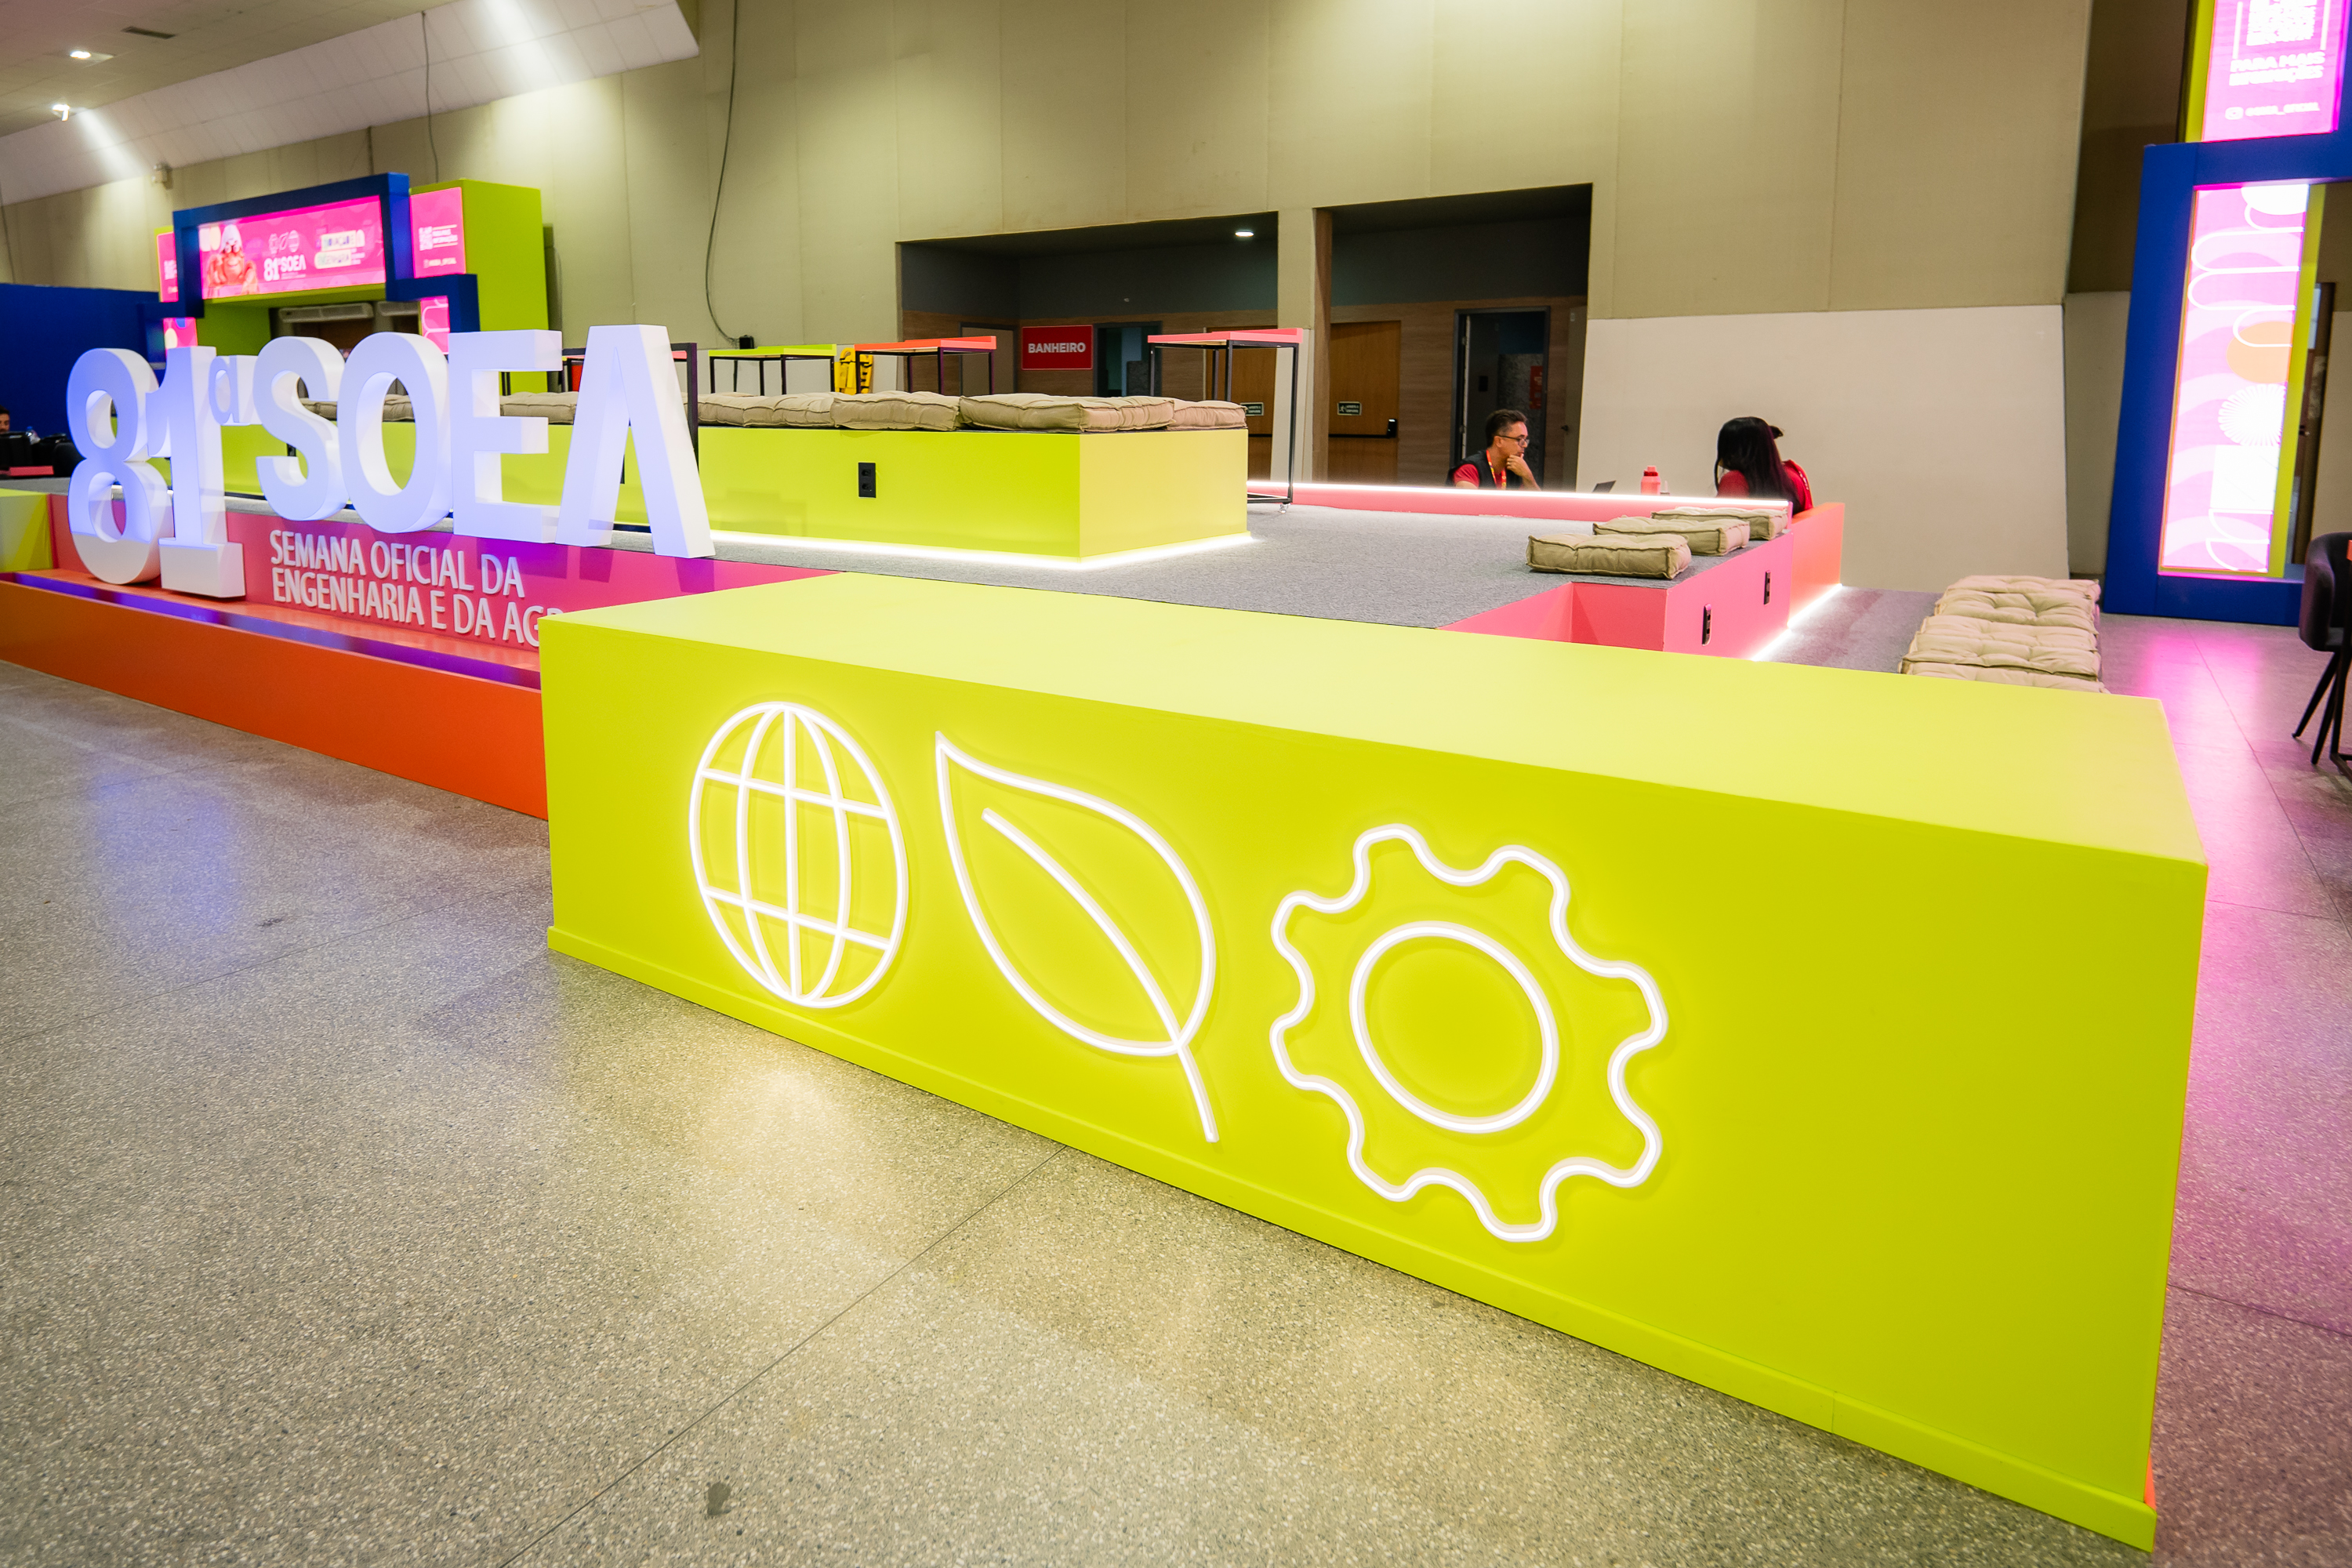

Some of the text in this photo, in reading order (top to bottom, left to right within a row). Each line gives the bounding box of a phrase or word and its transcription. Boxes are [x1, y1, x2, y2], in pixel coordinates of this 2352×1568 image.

[1028, 342, 1087, 354] BANHEIRO
[270, 529, 525, 598] SEMANA OFICIAL DA
[271, 566, 426, 626] ENGENHARIA
[430, 590, 448, 630] E
[453, 593, 496, 639] DA
